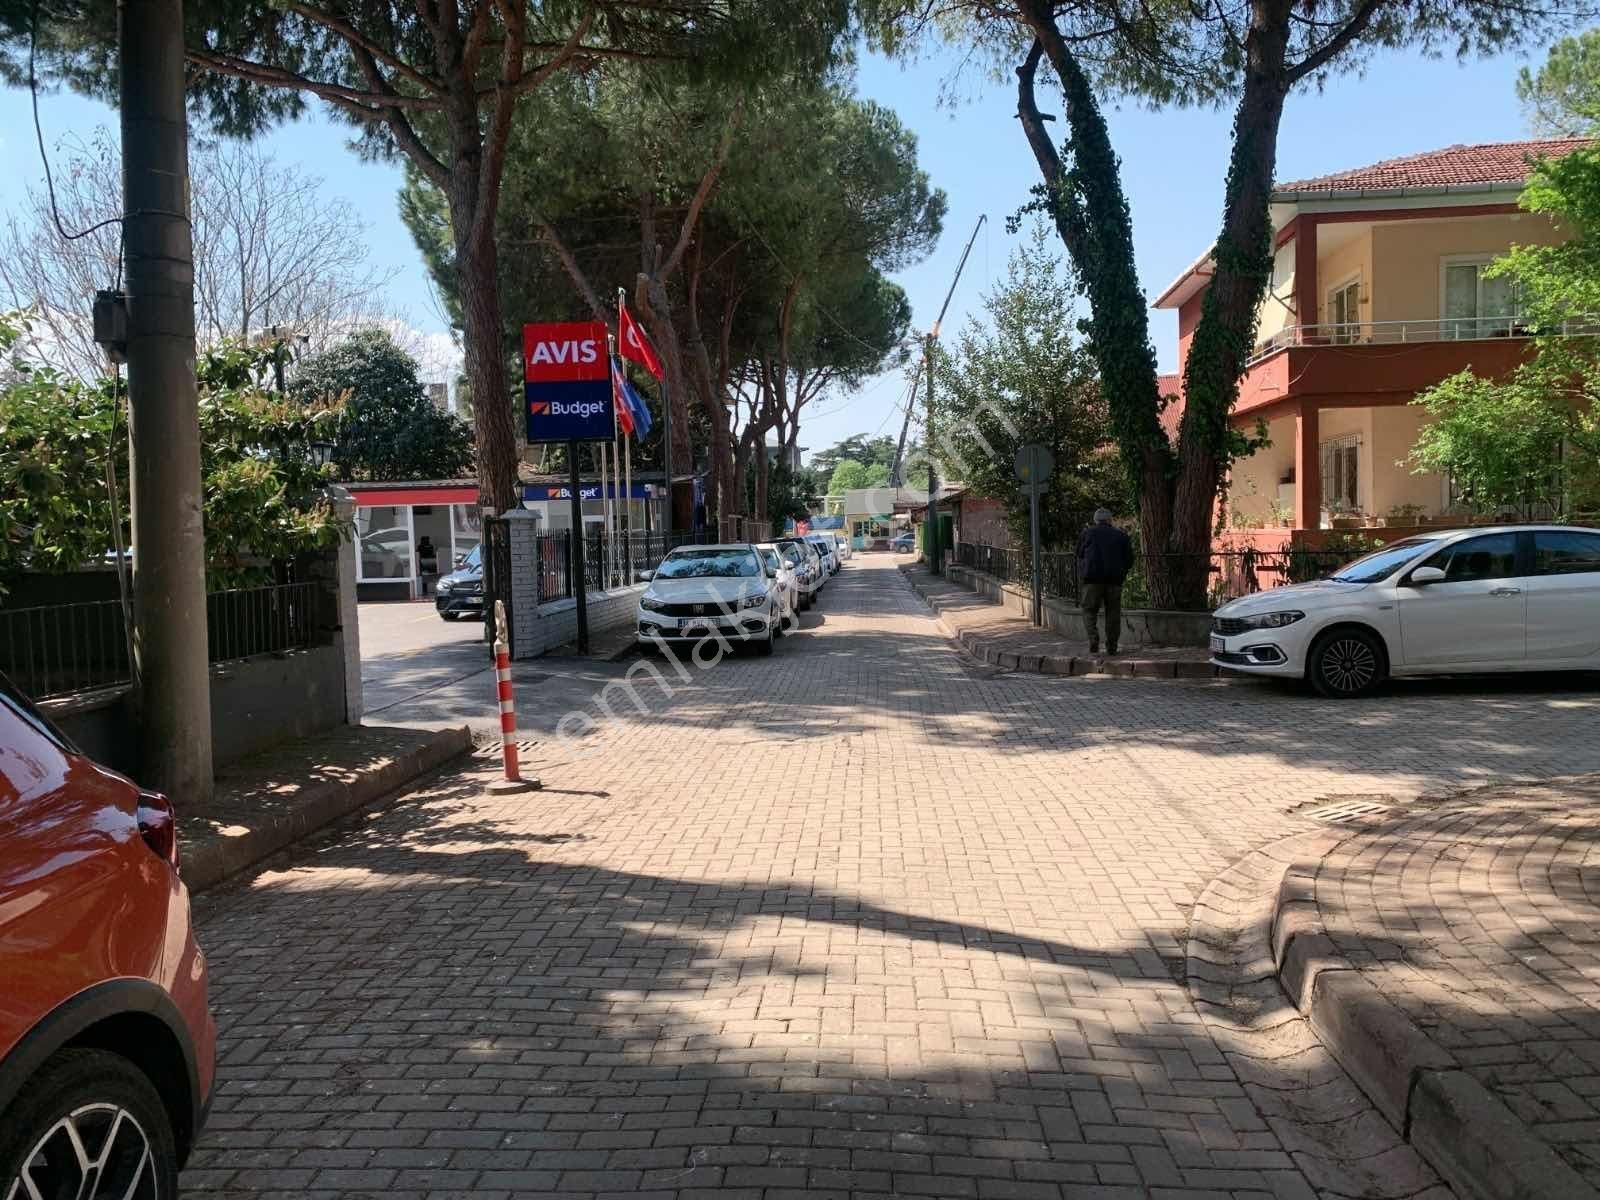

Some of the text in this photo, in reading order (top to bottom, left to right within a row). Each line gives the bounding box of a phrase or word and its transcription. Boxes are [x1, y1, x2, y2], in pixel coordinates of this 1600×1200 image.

[531, 340, 597, 364] AVIS
[551, 401, 604, 418] Budget
[561, 488, 596, 499] Buget
